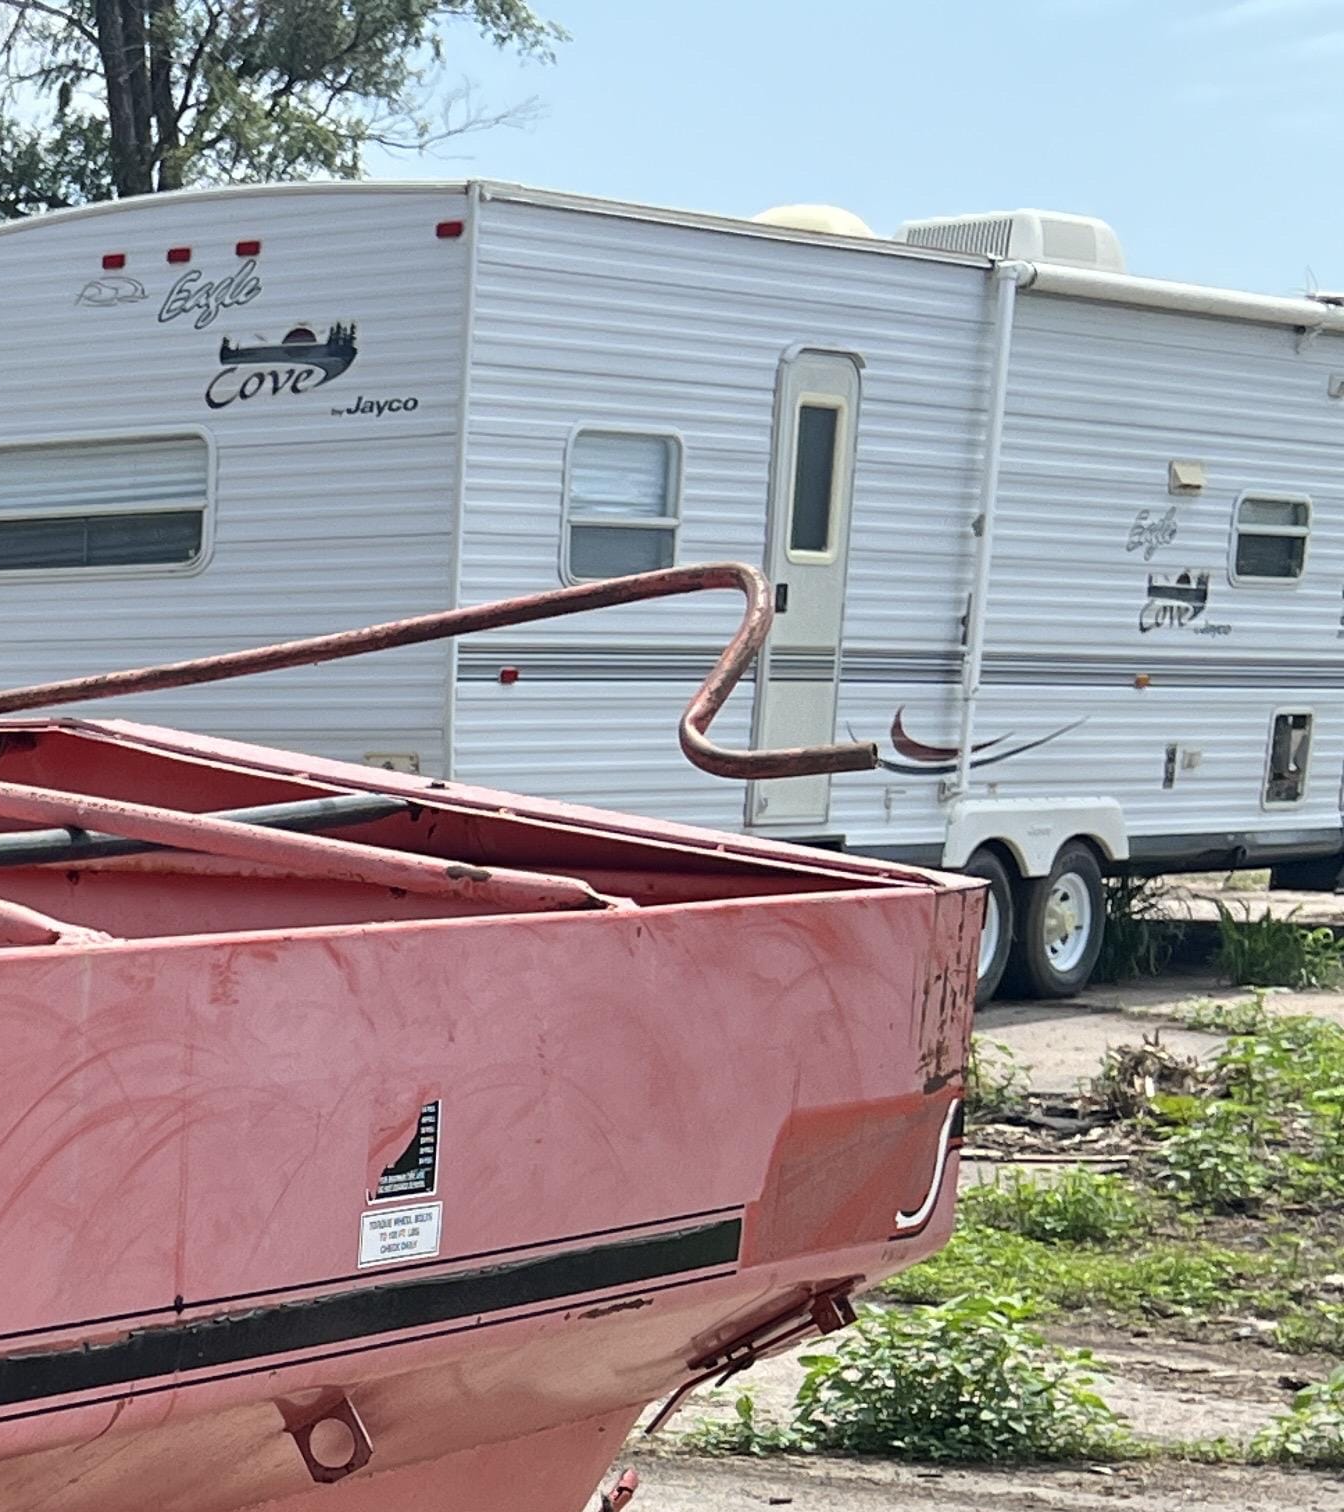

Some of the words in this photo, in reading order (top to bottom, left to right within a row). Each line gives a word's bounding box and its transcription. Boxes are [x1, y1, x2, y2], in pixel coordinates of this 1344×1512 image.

[157, 259, 262, 329] Eagle
[205, 365, 315, 410] Cove
[331, 407, 344, 416] by
[346, 396, 418, 417] Jayco
[1126, 506, 1178, 561] Eagle
